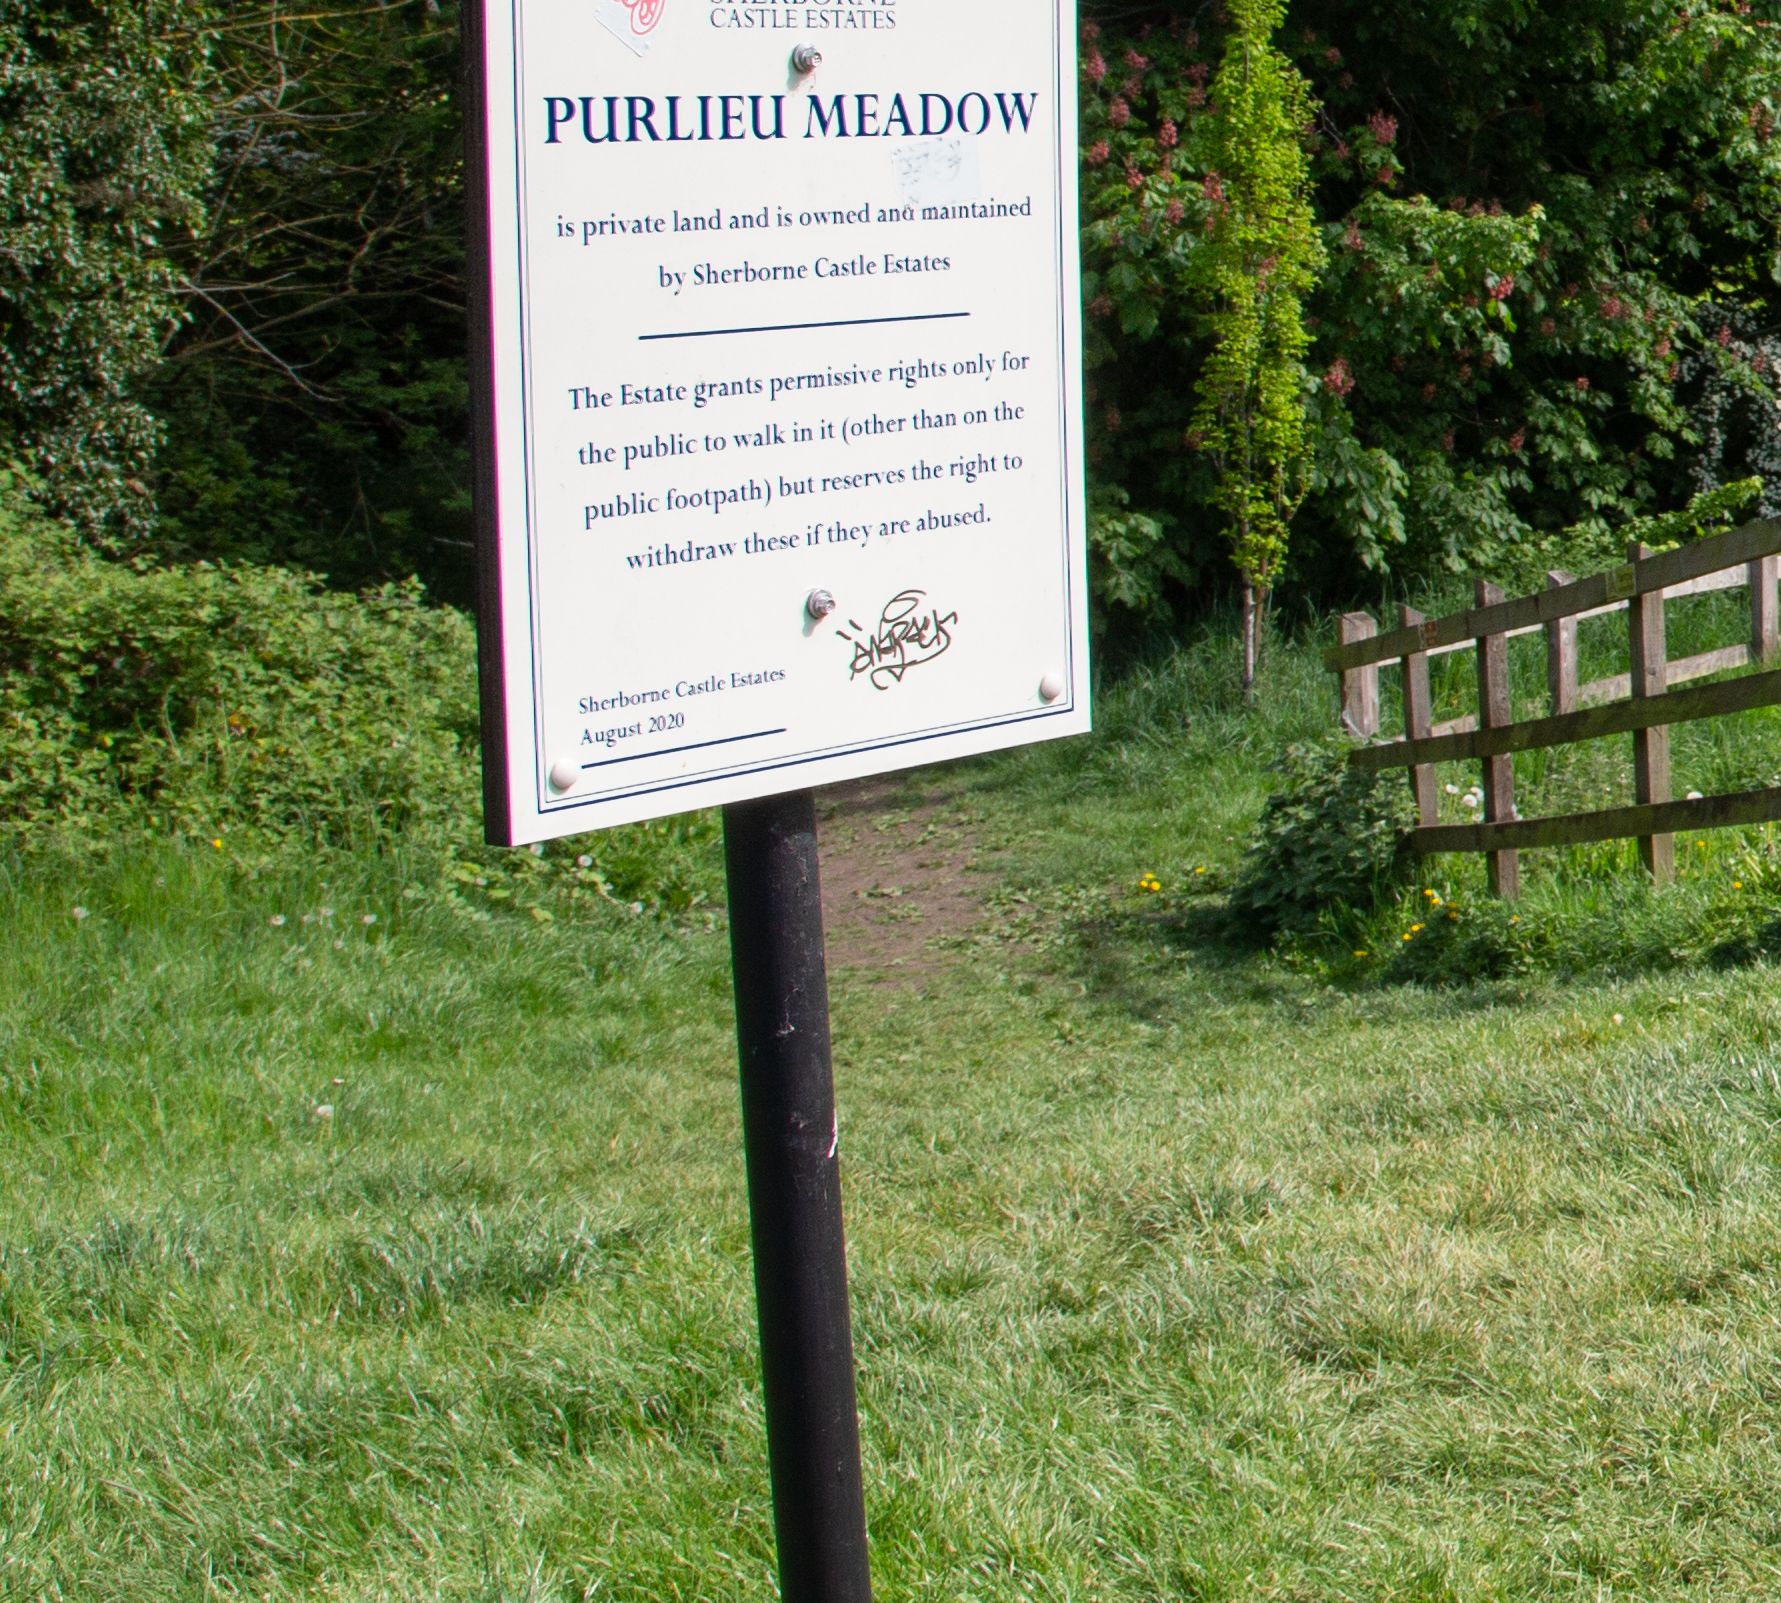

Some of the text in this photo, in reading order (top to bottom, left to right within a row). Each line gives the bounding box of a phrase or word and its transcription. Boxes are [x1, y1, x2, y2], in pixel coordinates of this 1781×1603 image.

[710, 8, 896, 29] CASTLE ESTATES
[543, 92, 1039, 144] PURLIEU MEADOW
[557, 215, 575, 238] is
[583, 214, 666, 246] private
[673, 208, 722, 234] land
[730, 206, 769, 230] and
[777, 204, 793, 228] is
[800, 203, 870, 227] owned
[922, 196, 1031, 220] maintained
[659, 253, 951, 295] by Sherborne Castle Estates
[568, 350, 1030, 411] The Estate grants permissive rights only for
[579, 401, 1025, 470] the public to walk in it (other than on the
[585, 452, 1023, 530] public footpath) but reserves the right to
[627, 503, 991, 570] withdraw these if they are abused.
[580, 668, 786, 715] Sherborne Castle Estates
[581, 711, 685, 748] August 2020
